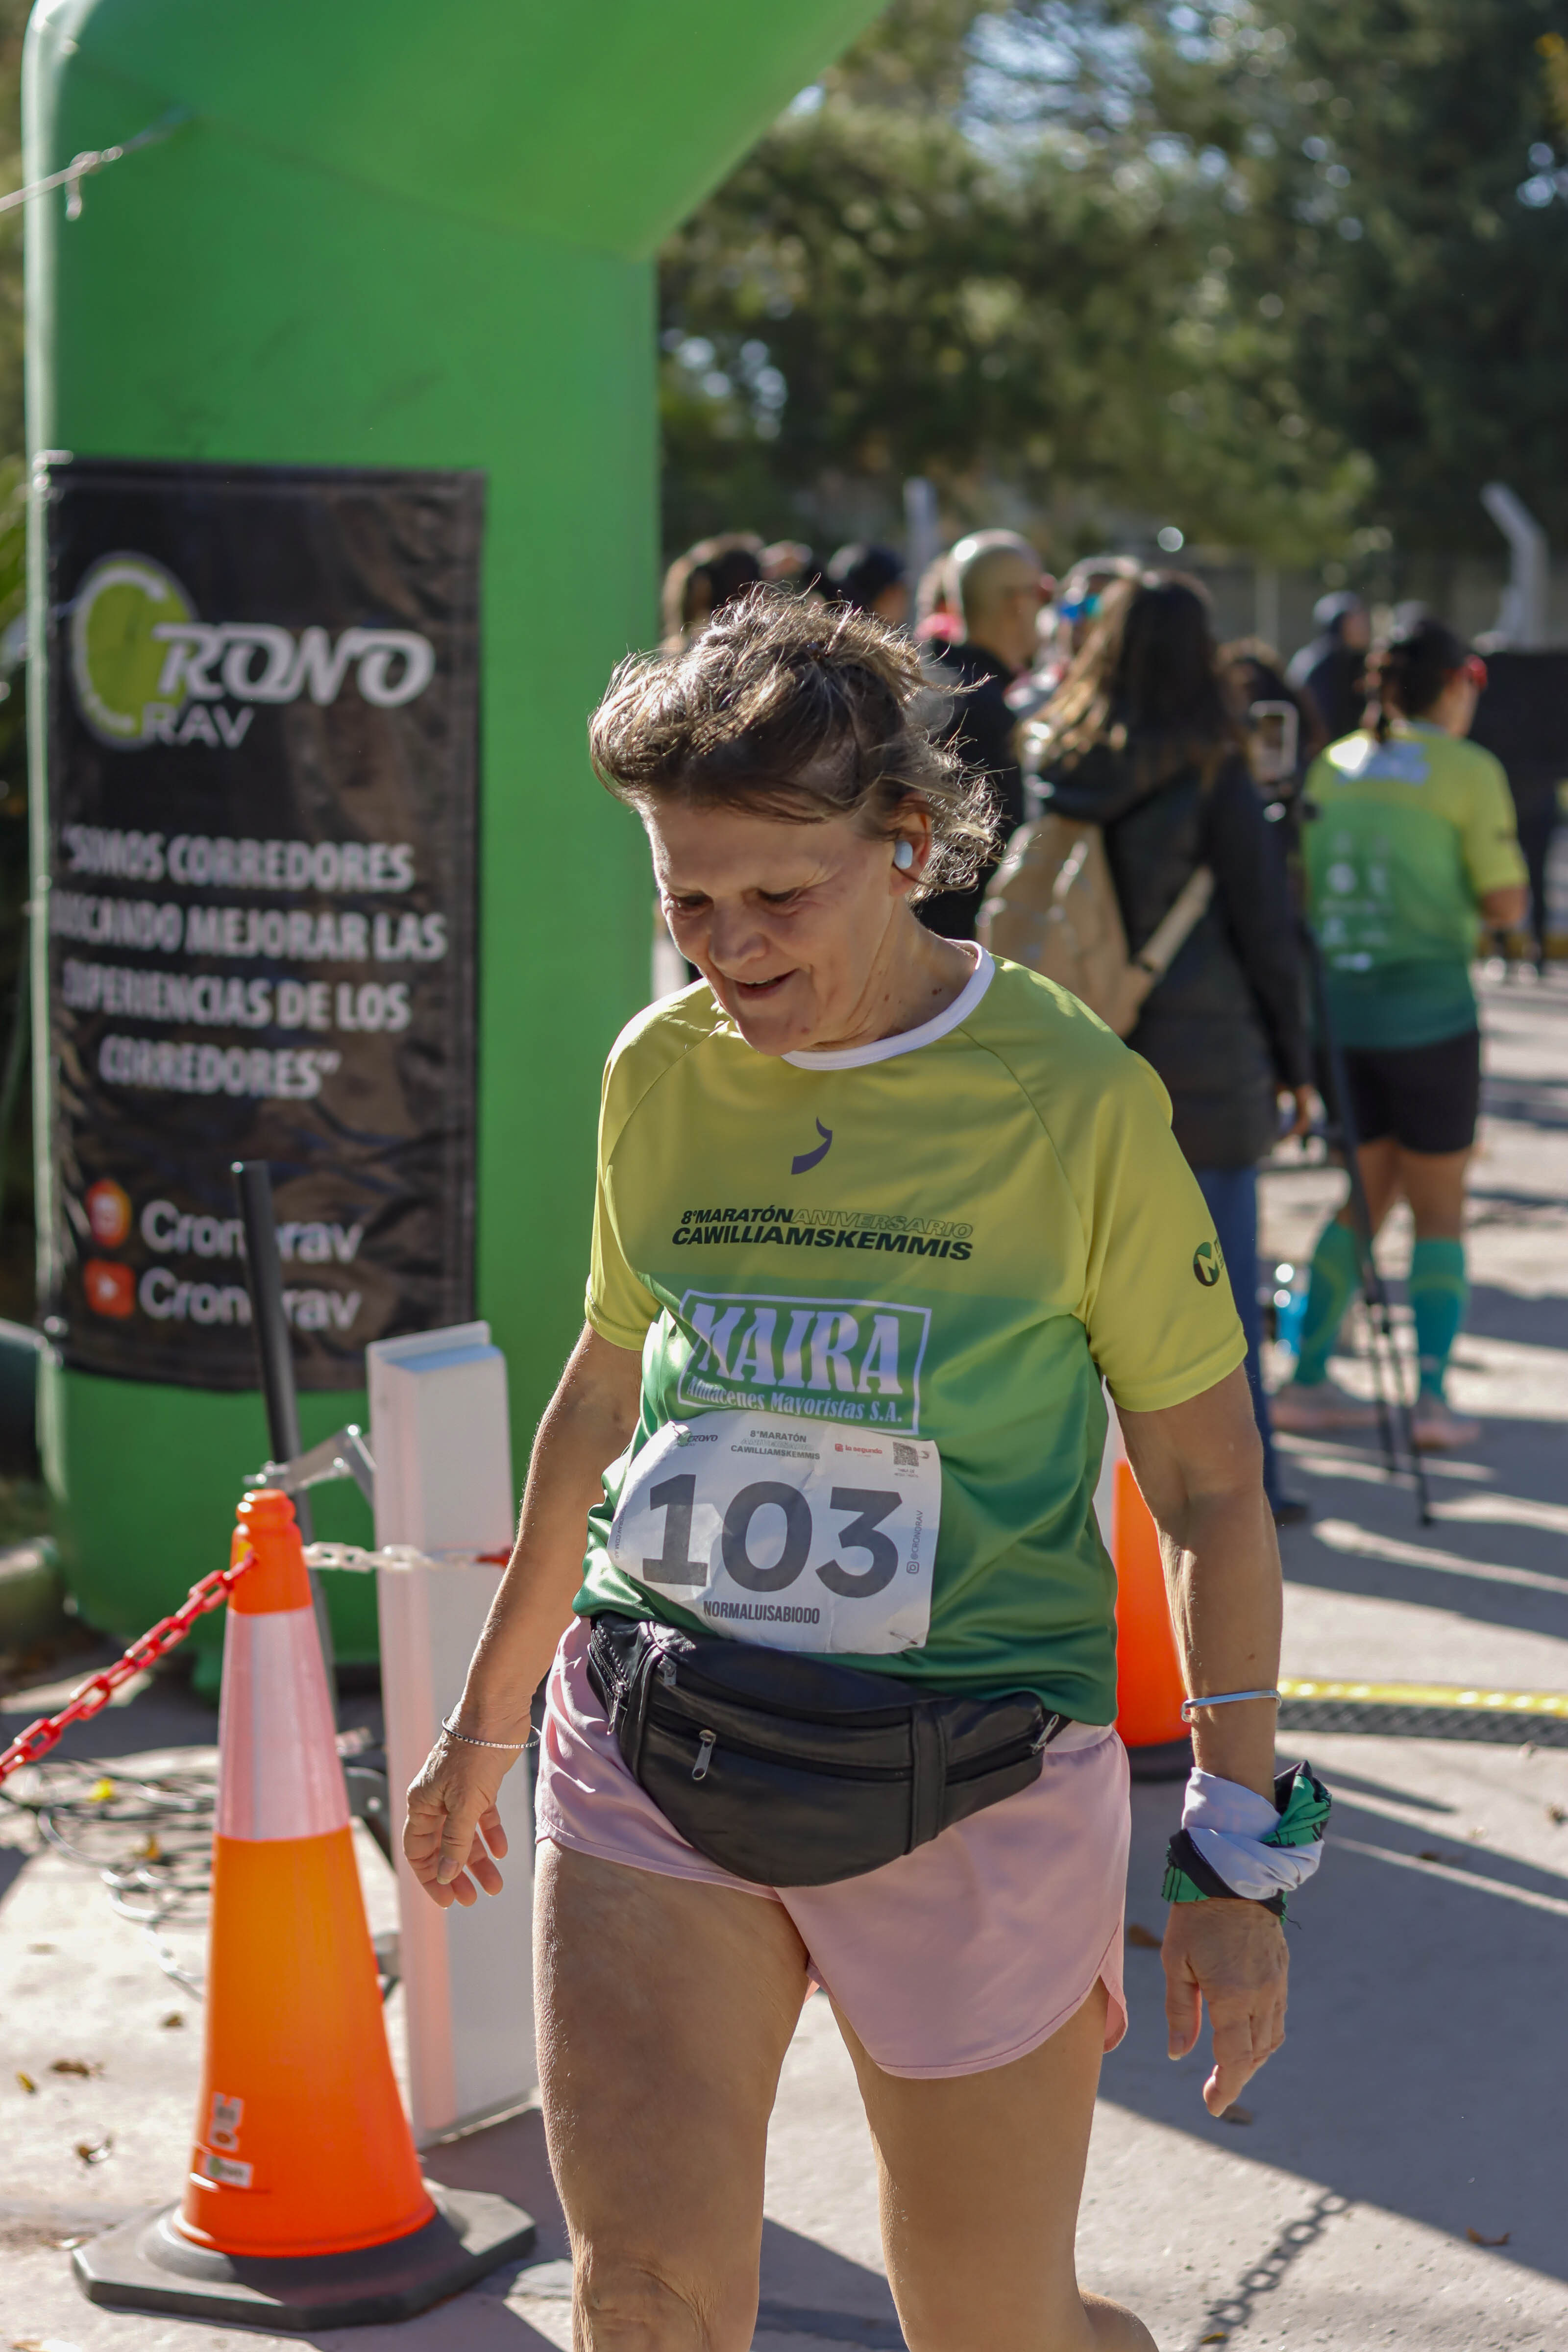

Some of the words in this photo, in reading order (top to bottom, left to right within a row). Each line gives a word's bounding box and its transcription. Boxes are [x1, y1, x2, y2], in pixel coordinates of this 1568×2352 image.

[142, 702, 255, 748] RAV
[167, 834, 416, 894] CORREDORES
[185, 906, 368, 961] MEJORAR
[374, 911, 448, 962] LAS
[275, 981, 332, 1031] DE
[337, 982, 412, 1033] LOS
[140, 1199, 365, 1264] Cronrav
[671, 1225, 973, 1261] CAWILLIAMSKEMMIS
[791, 1208, 974, 1239] ANIVERSARIO
[138, 1266, 363, 1330] Cronrav
[690, 1302, 903, 1395] MAIRA
[686, 1376, 766, 1411] Almacenes
[771, 1392, 864, 1420] Mayoristas
[870, 1400, 903, 1422] S.A.
[731, 1445, 821, 1460] CAWILLIAMSKEMMIS
[642, 1473, 903, 1598] 103
[703, 1600, 820, 1625] NORMALUISABIODO
